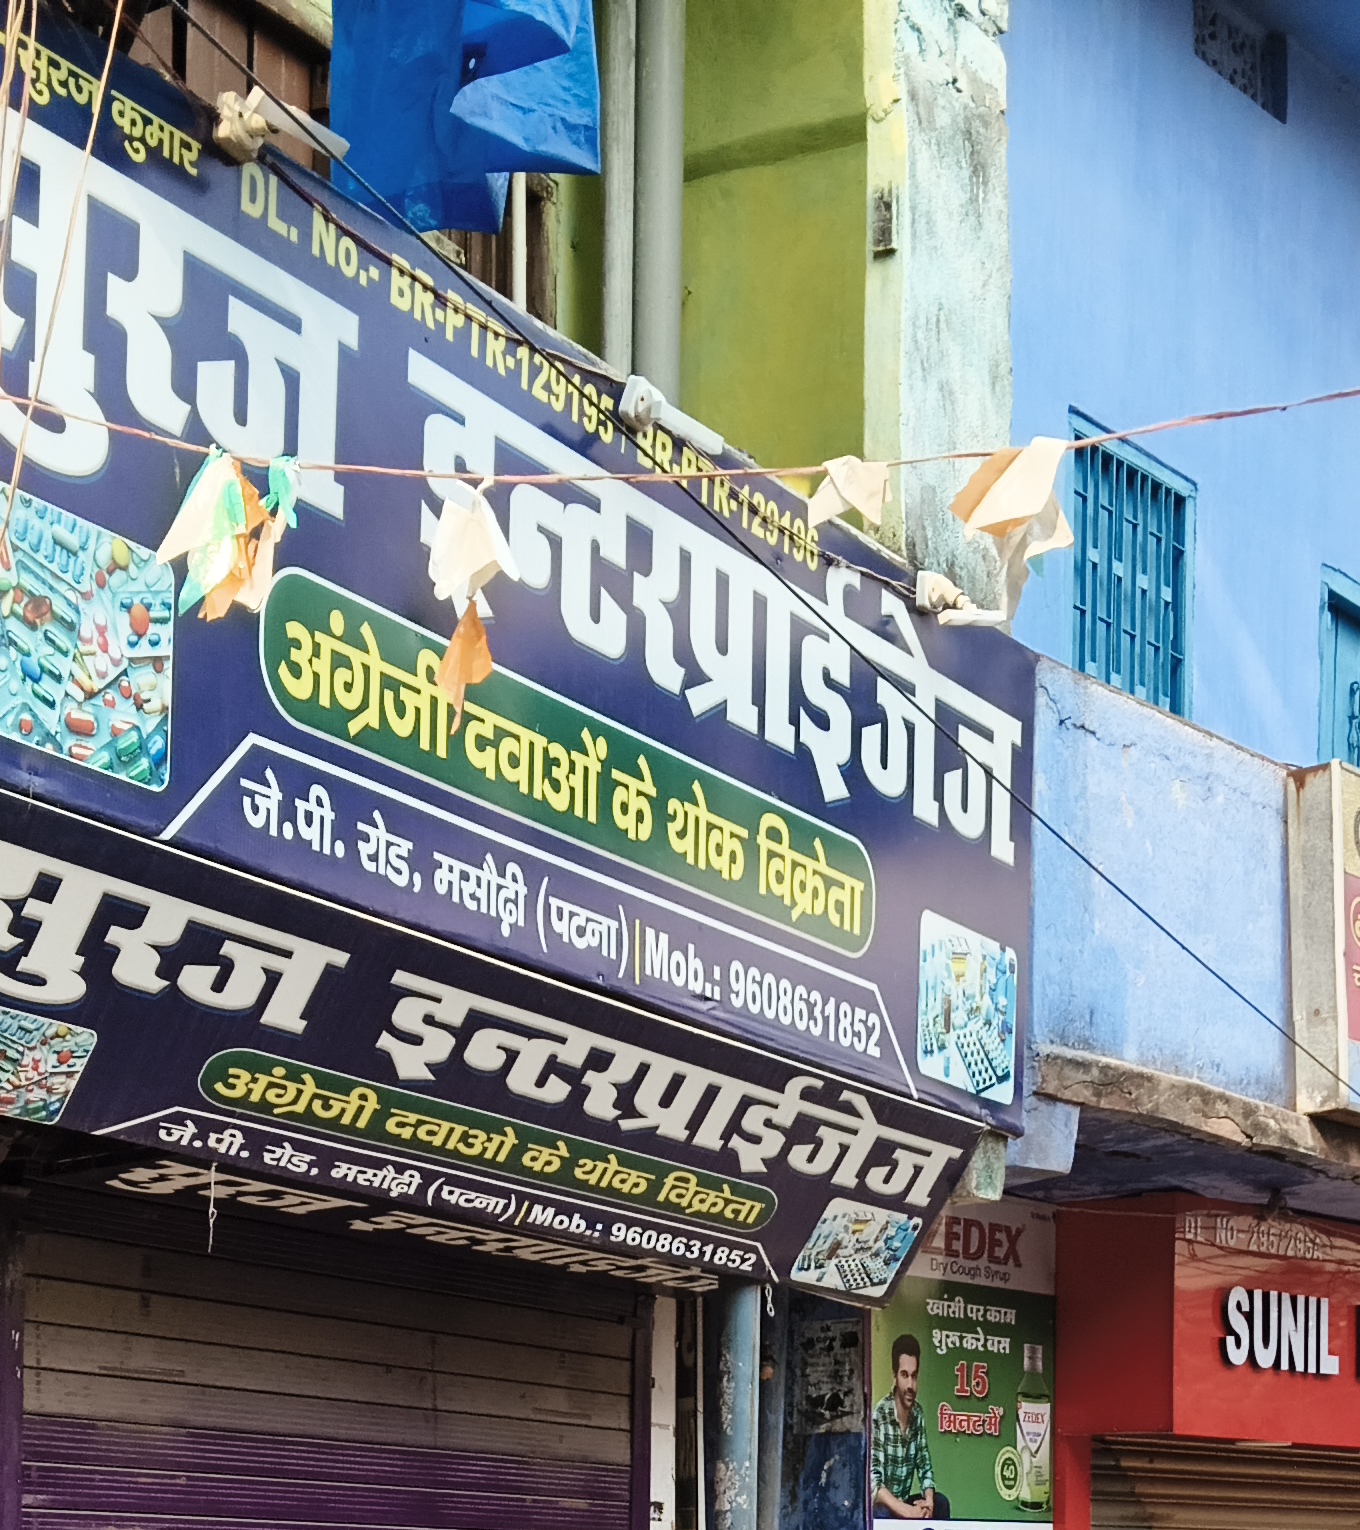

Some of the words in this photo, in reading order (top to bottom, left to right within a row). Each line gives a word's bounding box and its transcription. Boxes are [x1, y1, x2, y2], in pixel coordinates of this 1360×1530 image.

[111, 89, 202, 177] कुमार
[239, 161, 299, 244] DL.
[276, 608, 452, 760] अंग्रेजी
[462, 697, 609, 823] दवाओं
[610, 755, 656, 842] के
[666, 780, 749, 882] थोक
[756, 810, 866, 936] विक्रेता
[356, 810, 422, 895] रोड,
[728, 962, 883, 1059] 9608631852
[213, 1066, 381, 1130] अंग्रेजी
[521, 1140, 571, 1175] के
[572, 1153, 656, 1196] थोक
[656, 1170, 766, 1225] विक्रेता
[262, 1142, 319, 1177] रोड,
[609, 1222, 758, 1272] 9608631852
[921, 1214, 1023, 1269] ZEDEX
[925, 1293, 965, 1319] खांसी
[966, 1303, 985, 1322] पर
[929, 1257, 949, 1275] Dry
[949, 1260, 983, 1282] Cough
[983, 1265, 1012, 1284] Syrup
[1225, 1286, 1340, 1376] SUNIL
[937, 1402, 985, 1434] मिनट
[954, 1360, 989, 1397] 15
[1022, 1410, 1046, 1425] ZEDEX
